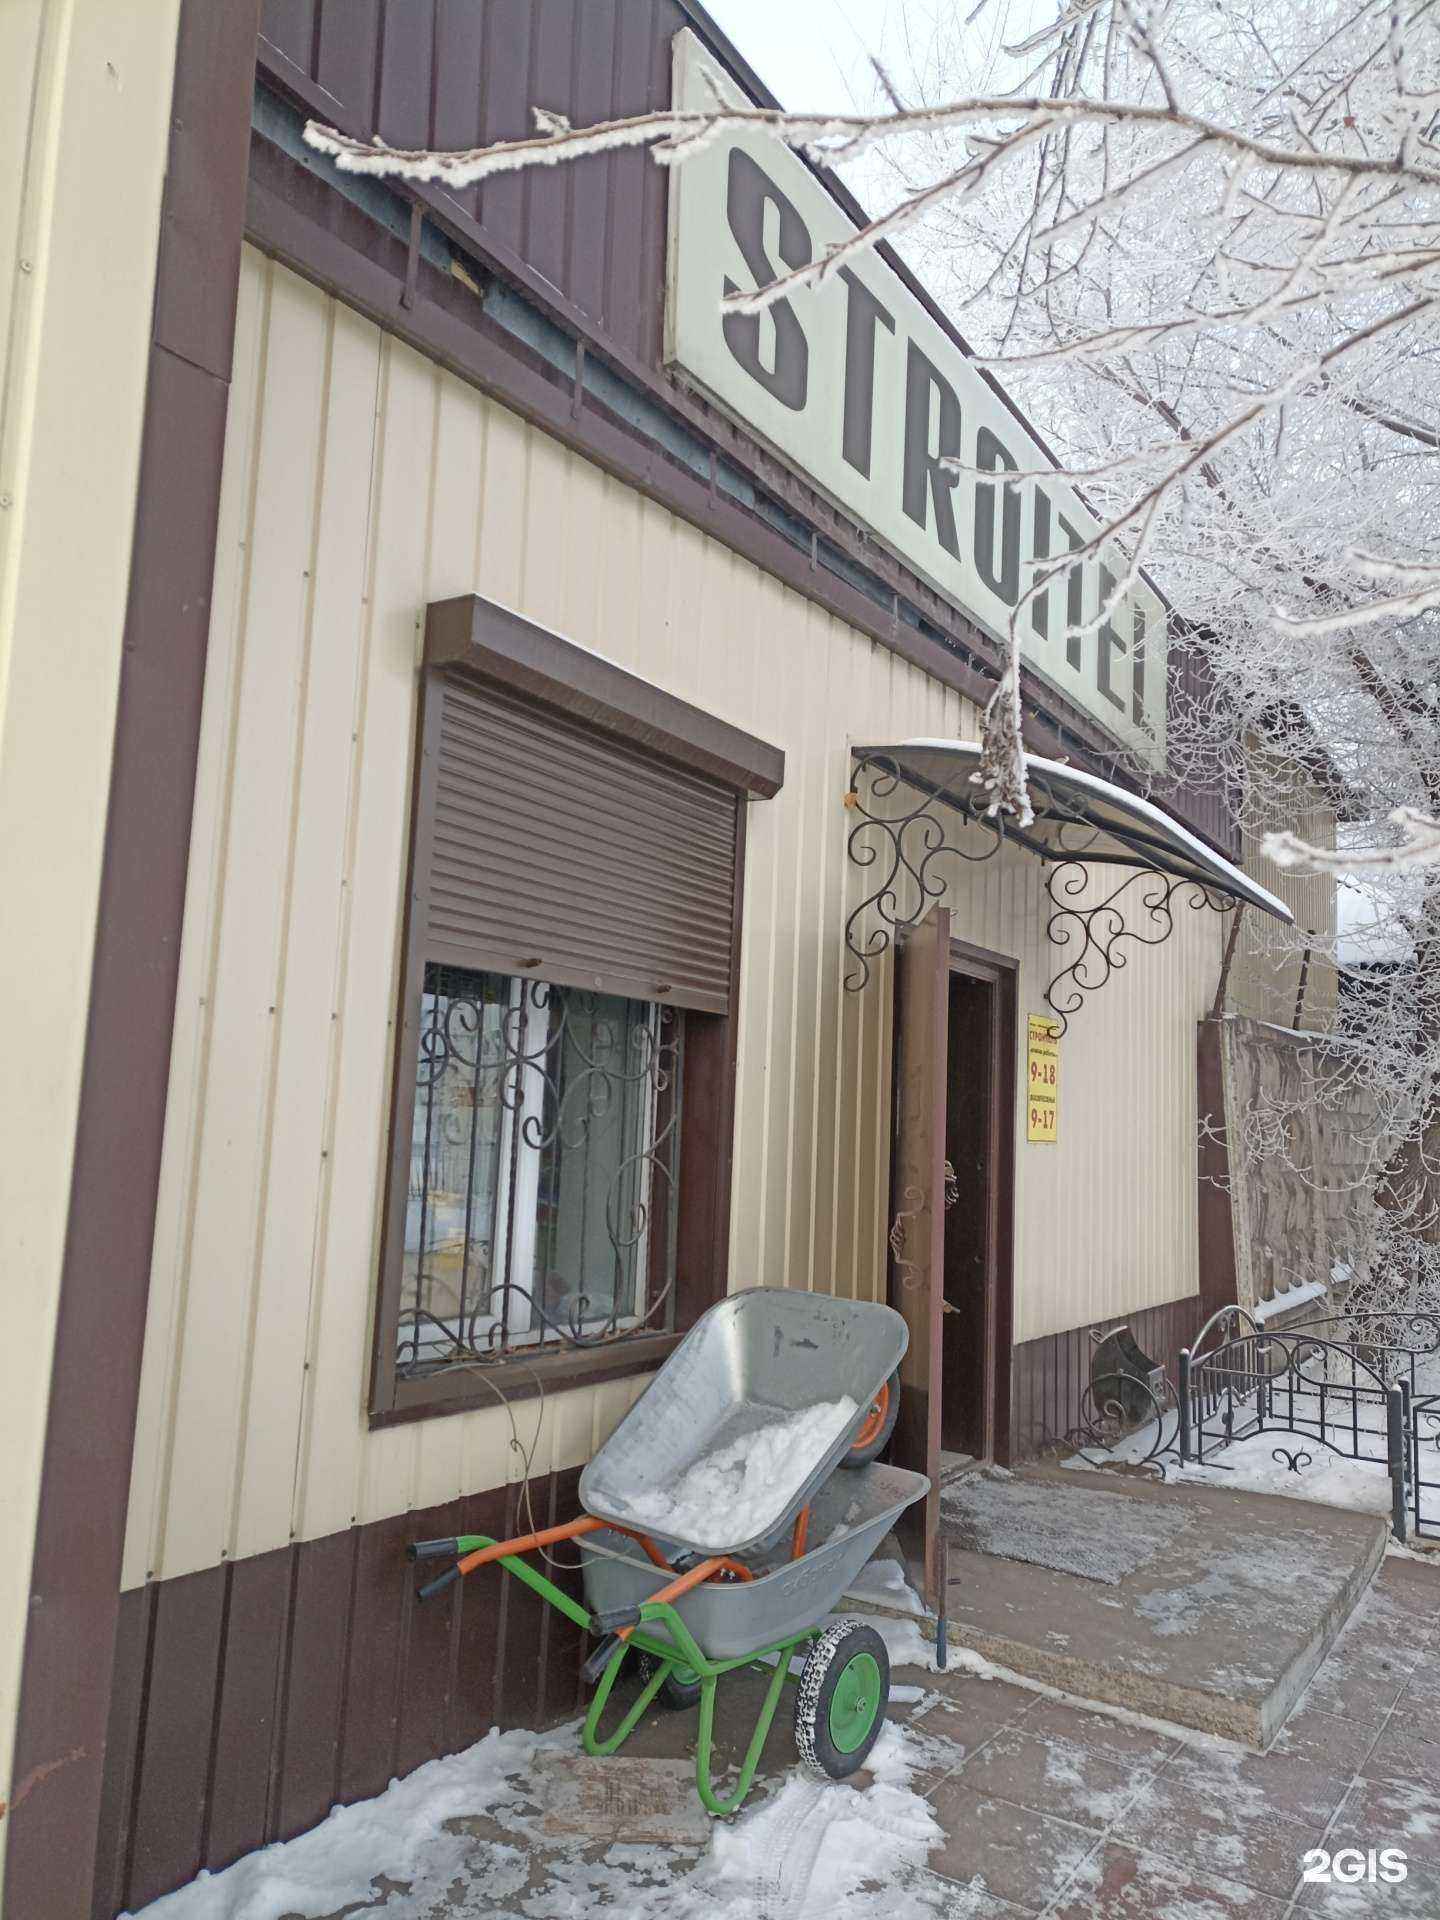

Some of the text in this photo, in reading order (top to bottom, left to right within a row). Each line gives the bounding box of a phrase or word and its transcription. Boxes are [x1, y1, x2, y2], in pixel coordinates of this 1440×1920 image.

[723, 147, 1155, 742] STROITEL
[1030, 1061, 1056, 1085] 9-18
[1030, 1108, 1055, 1129] 9-17
